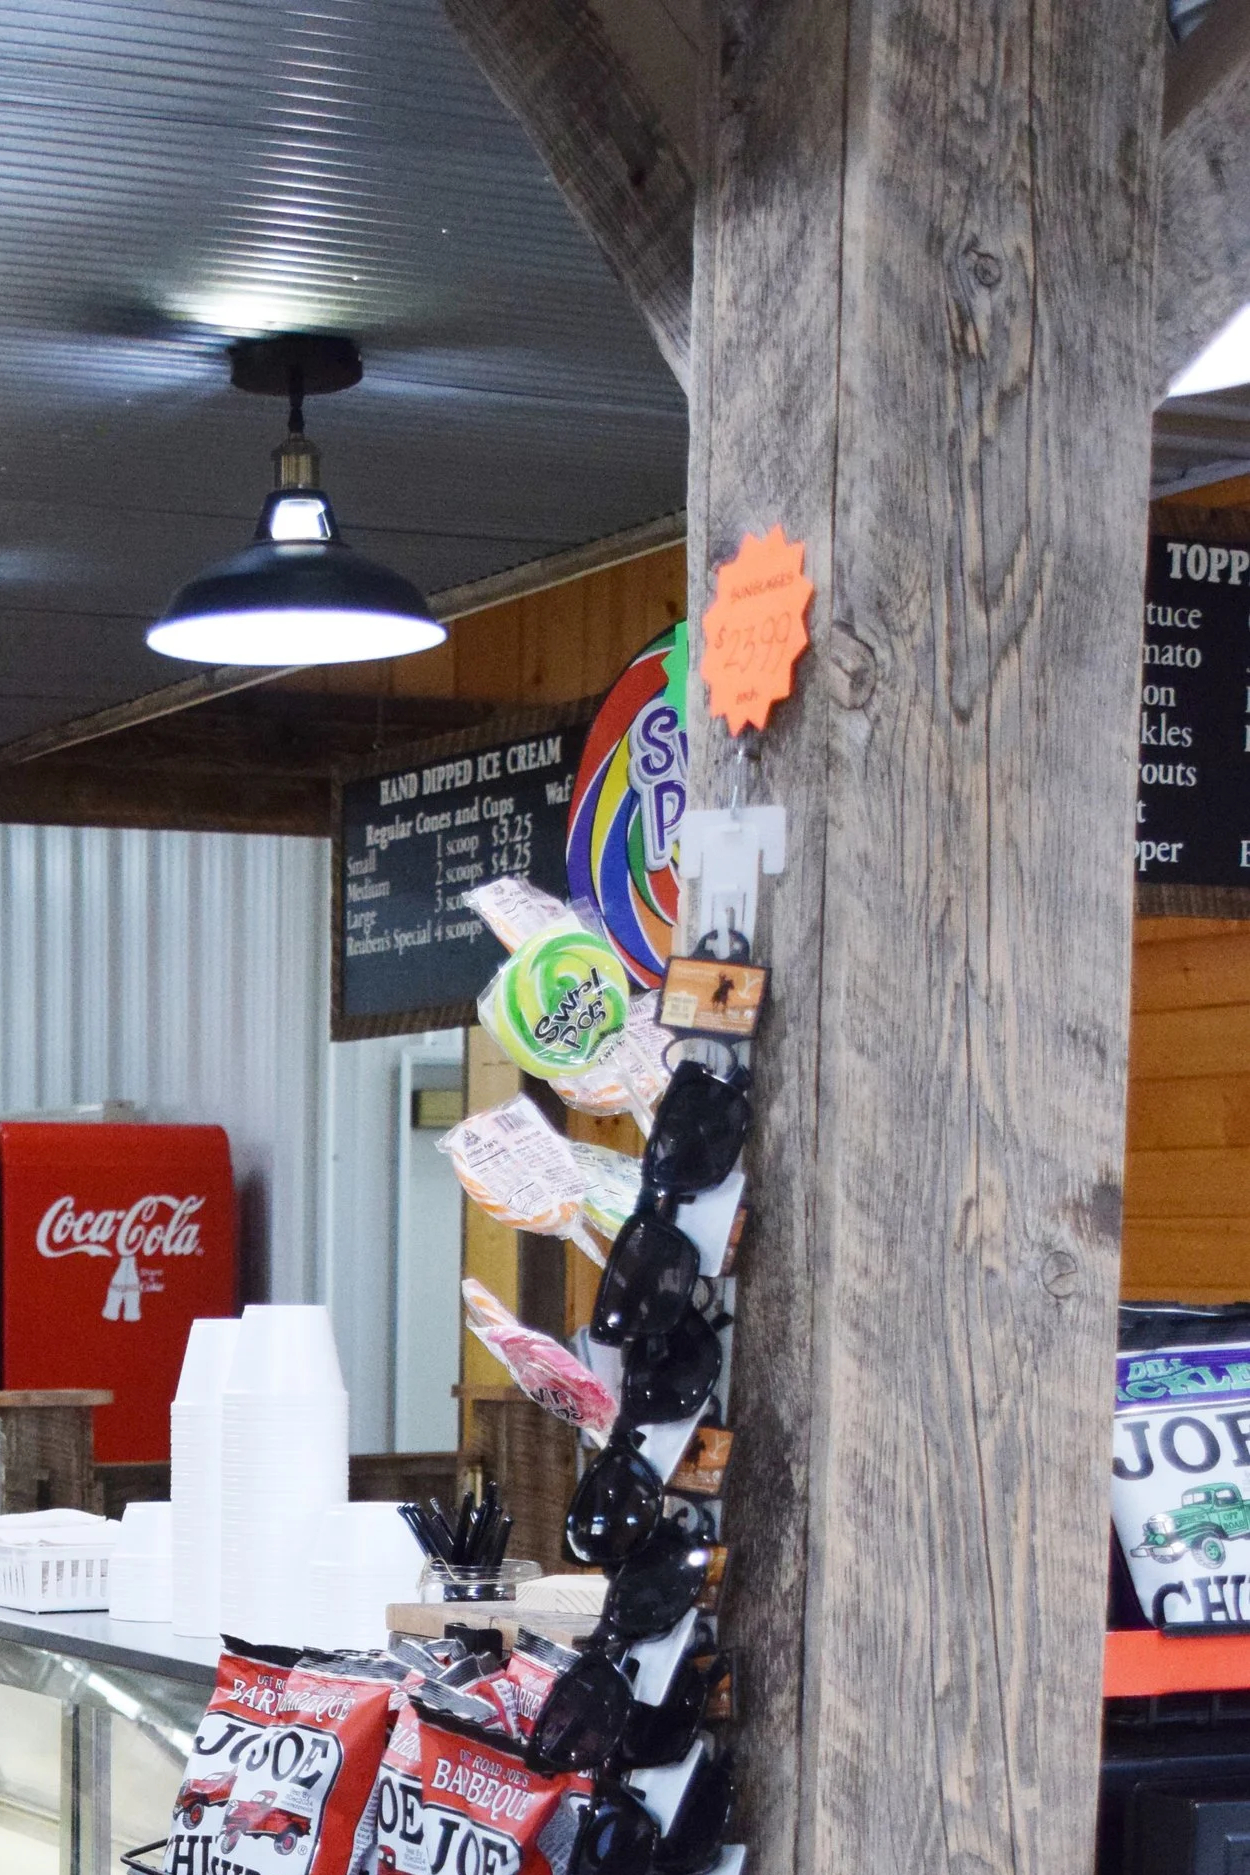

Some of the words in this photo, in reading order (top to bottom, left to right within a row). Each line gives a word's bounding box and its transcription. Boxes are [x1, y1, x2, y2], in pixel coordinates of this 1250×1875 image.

[1167, 542, 1250, 587] TOPP
[1144, 600, 1202, 629] tuce
[1140, 711, 1193, 748] kles
[379, 773, 419, 806] HAND
[422, 758, 473, 796] DIPPED
[476, 751, 501, 783] ICE
[506, 736, 563, 775] CREAM
[1141, 763, 1197, 787] outs
[346, 849, 377, 878] Small
[446, 834, 480, 859] scoop
[491, 812, 533, 847] $3.25
[365, 815, 414, 850] Regular
[415, 810, 451, 835] Cones
[454, 796, 480, 824] and
[482, 796, 515, 826] Cups
[445, 860, 485, 889] scoops
[491, 841, 532, 876] $4.25
[445, 919, 485, 945] scoops
[36, 1194, 206, 1258] Coca-Cola
[1117, 1361, 1250, 1403] CKLE
[1127, 1357, 1191, 1383] DILL
[377, 1774, 425, 1845] OE
